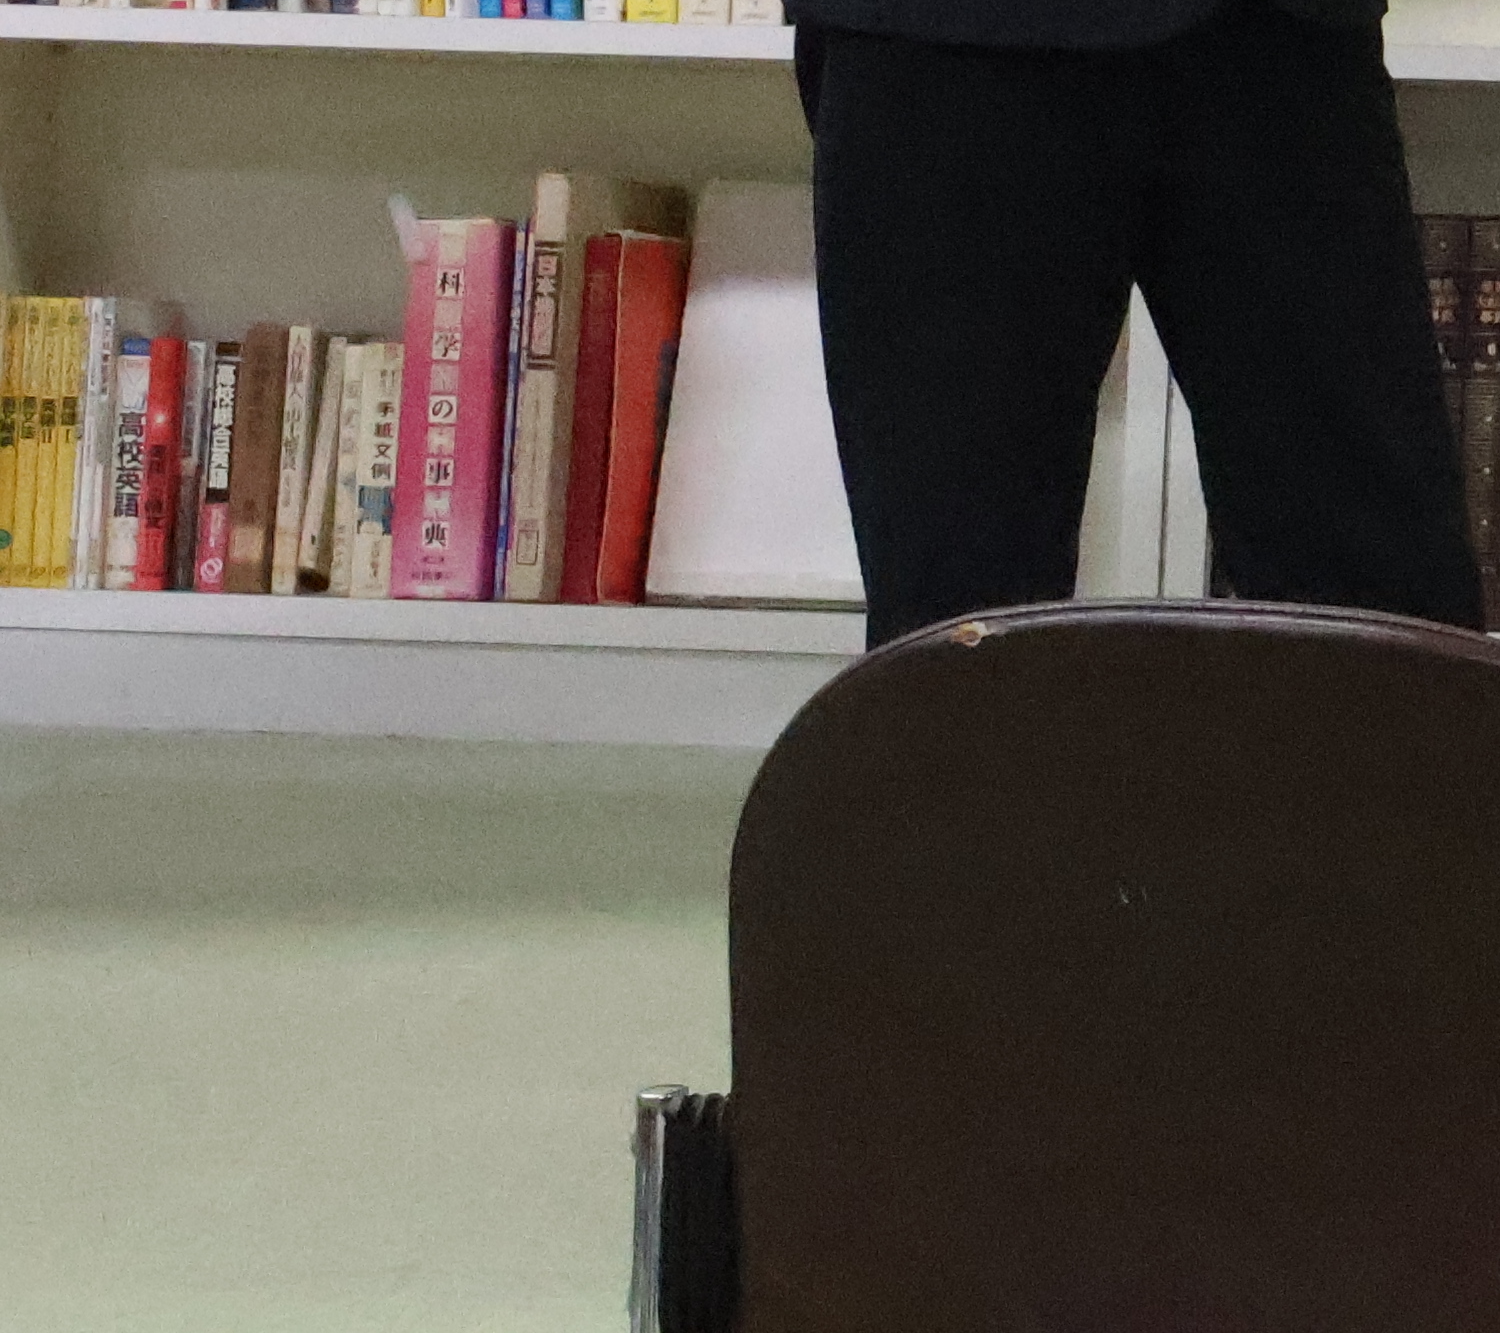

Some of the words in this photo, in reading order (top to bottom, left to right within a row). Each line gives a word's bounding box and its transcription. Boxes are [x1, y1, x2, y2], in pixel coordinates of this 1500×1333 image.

[421, 265, 465, 549] 科学の事典
